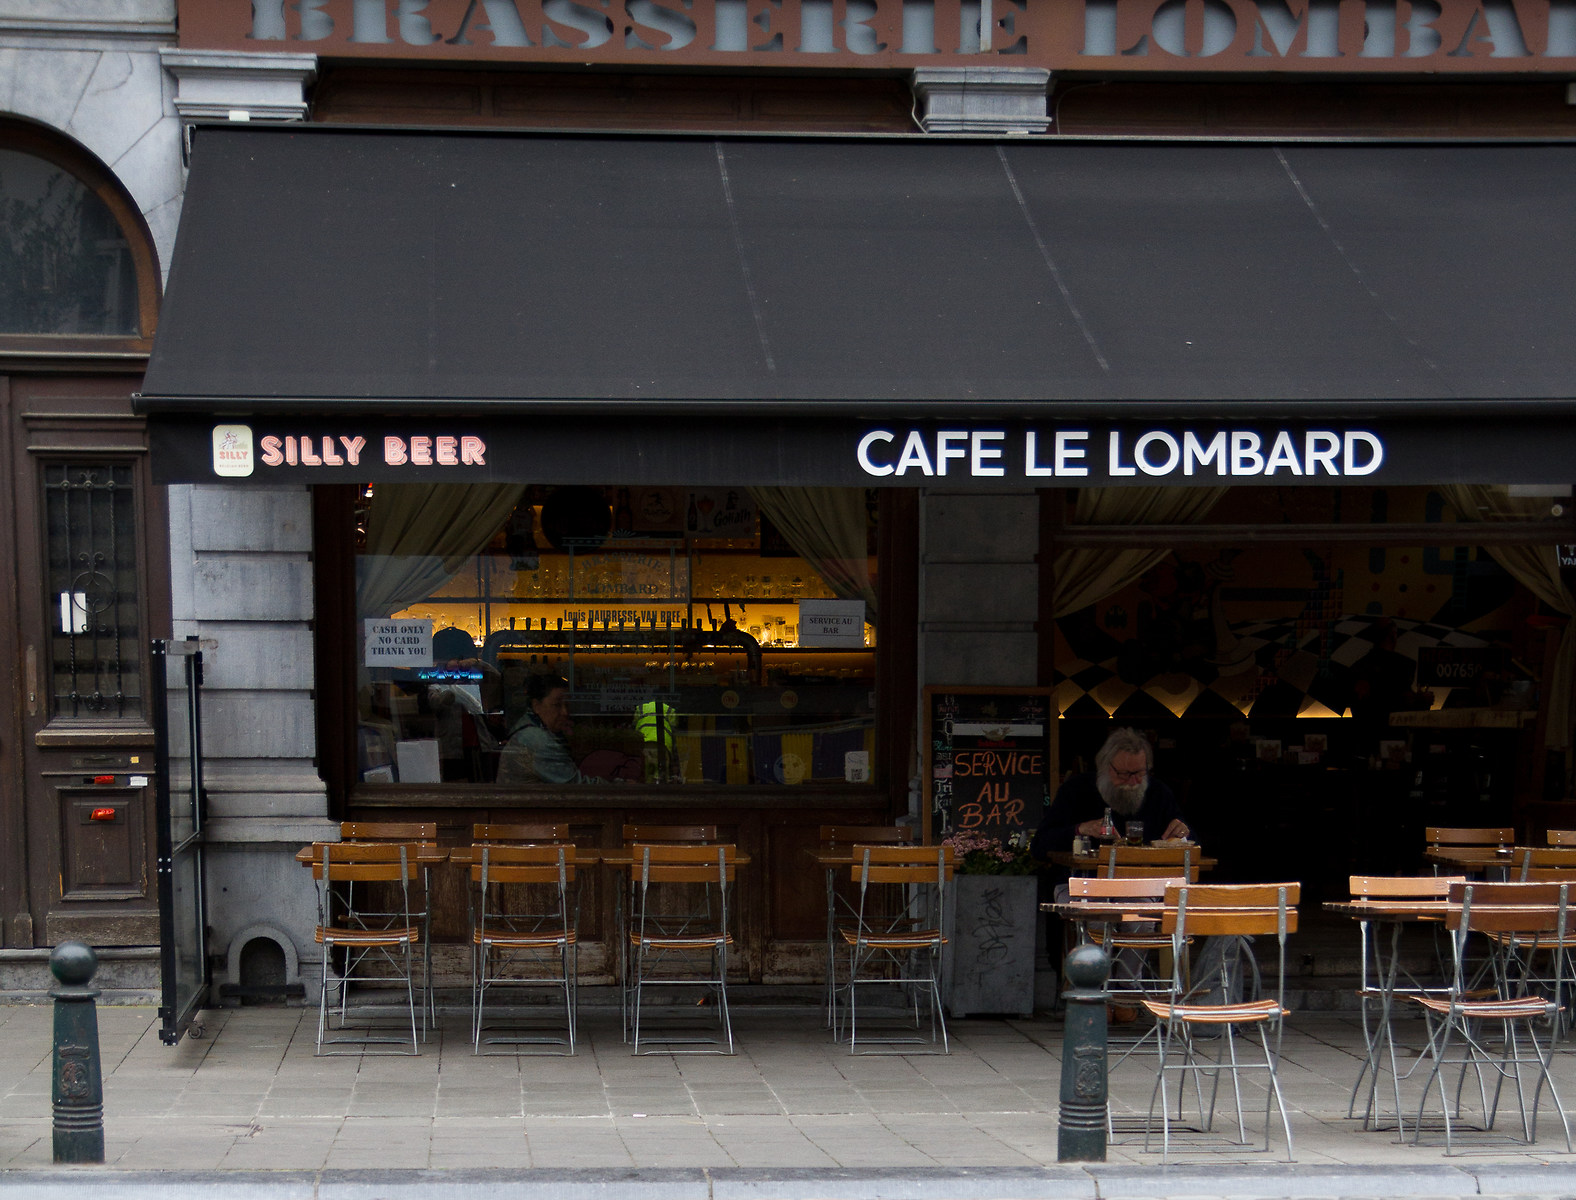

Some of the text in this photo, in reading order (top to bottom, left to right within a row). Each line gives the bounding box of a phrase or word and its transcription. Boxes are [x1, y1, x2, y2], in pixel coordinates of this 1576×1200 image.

[245, 0, 1028, 54] BRASSERIE
[219, 450, 248, 460] SILLY
[261, 435, 501, 466] SILLY BEER
[857, 430, 1384, 477] CAFE LE LOMBARD
[587, 583, 658, 595] LOMBARD
[564, 610, 586, 622] Louis
[640, 610, 658, 622] VAN
[809, 617, 840, 625] SERVICE
[372, 626, 425, 634] CASH ONLY
[379, 636, 420, 645] NO CARD
[371, 647, 427, 655] THANK YOU
[954, 751, 1042, 776] SERVICE
[976, 781, 1010, 804] AU
[958, 798, 1024, 829] BAR
